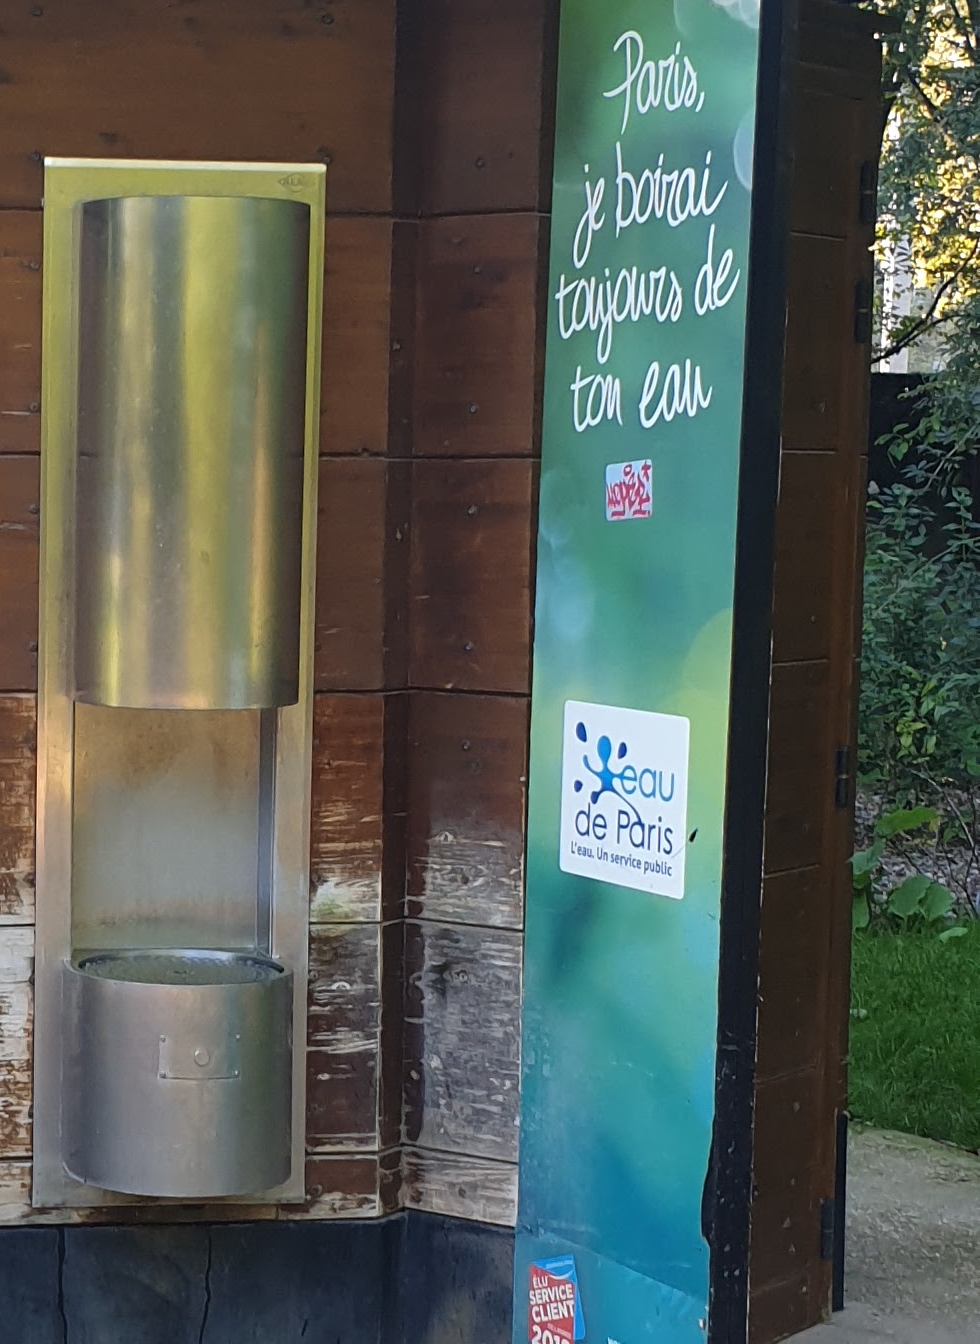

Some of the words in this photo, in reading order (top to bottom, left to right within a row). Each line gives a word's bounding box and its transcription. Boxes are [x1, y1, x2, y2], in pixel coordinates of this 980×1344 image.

[603, 30, 705, 134] Paris,
[572, 163, 605, 268] je
[614, 141, 728, 238] boirai
[555, 262, 682, 363] toujours
[694, 223, 740, 317] de
[570, 365, 623, 433] ton
[639, 358, 713, 429] eau
[619, 764, 675, 802] eau
[575, 802, 608, 841] de
[617, 809, 673, 855] Paris
[570, 841, 595, 860] L'eau.
[596, 846, 609, 862] Un
[610, 853, 642, 869] service
[643, 858, 673, 876] public
[529, 1283, 574, 1306] SERVICE
[531, 1300, 575, 1324] CLIENT
